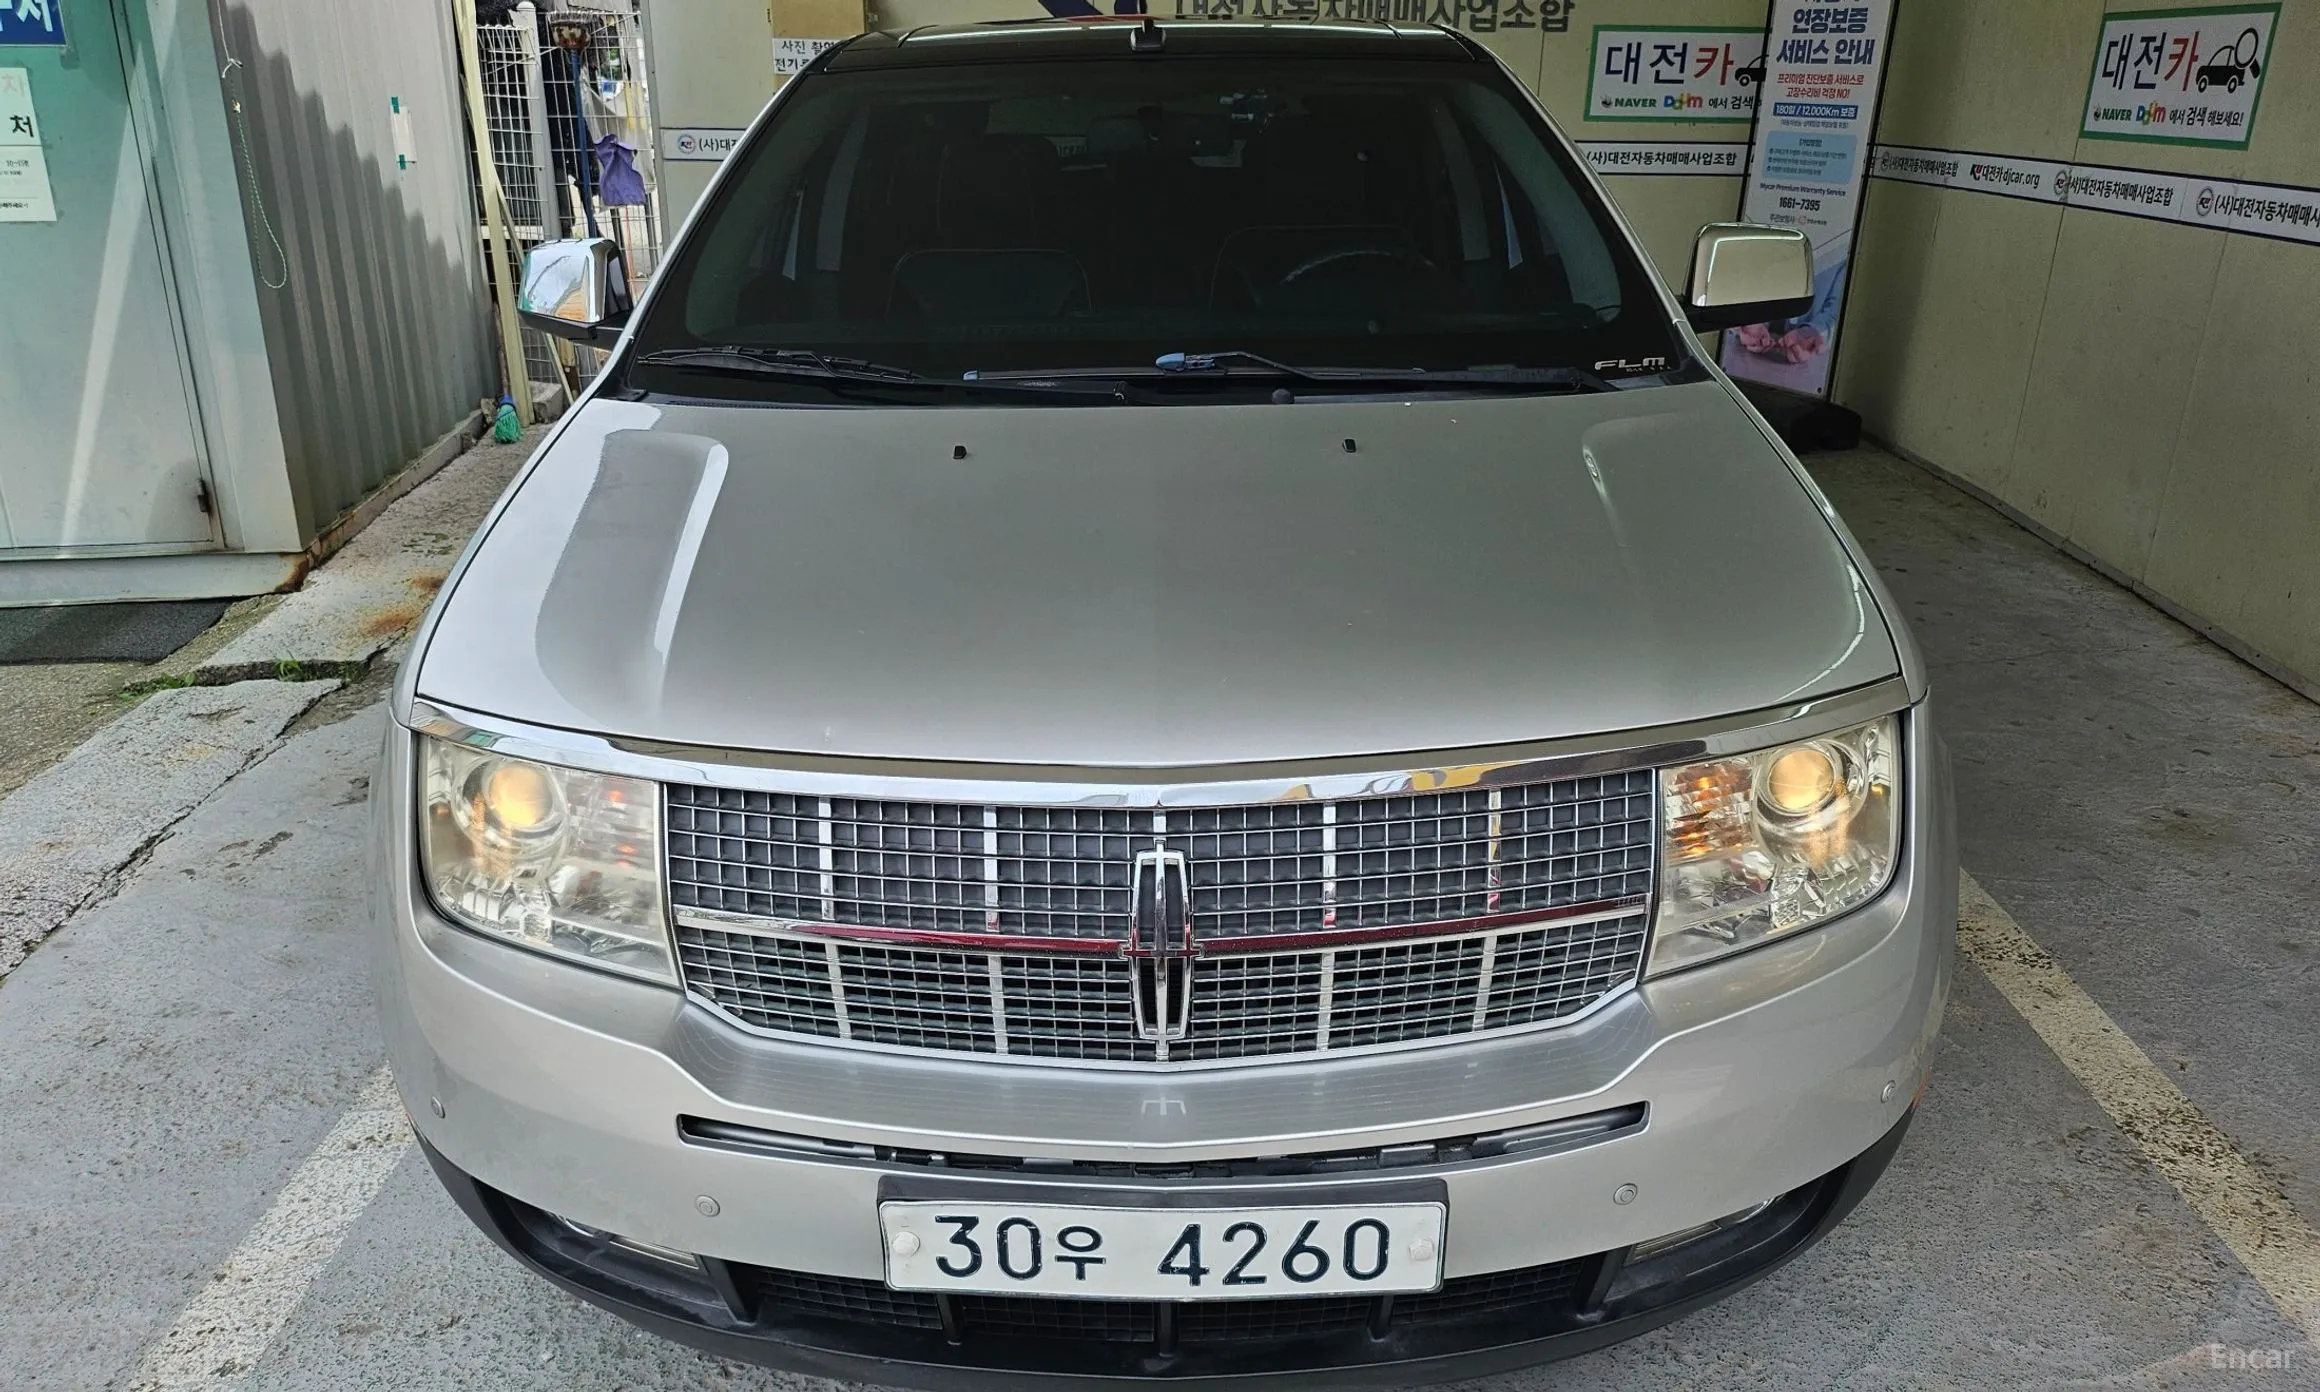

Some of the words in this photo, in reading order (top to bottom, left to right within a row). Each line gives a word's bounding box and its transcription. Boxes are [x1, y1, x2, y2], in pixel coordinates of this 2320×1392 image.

[1792, 8, 1868, 33] 연장보증
[782, 40, 806, 54] 사진
[1776, 40, 1829, 64] 서비스
[1834, 39, 1875, 64] 안내
[1605, 42, 1734, 86] 대전카
[2102, 31, 2200, 92] 대전카
[1777, 73, 1805, 84] 프리미엄
[1806, 74, 1834, 85] 진단보증
[1835, 74, 1865, 85] 서비스로
[1786, 87, 1821, 97] 고장수리비
[1822, 88, 1836, 99] 걱정
[1837, 88, 1851, 99] NO!
[1614, 98, 1657, 108] NAVER
[1708, 97, 1728, 109] 에서
[1776, 105, 1796, 115] 180일
[1840, 107, 1857, 118] 보증
[2102, 107, 2132, 121] NAVER
[2169, 110, 2185, 125] 에서
[2187, 106, 2207, 126] 검색
[2207, 111, 2244, 127] 해보세요!
[1587, 152, 1737, 166] (사)대전자동차매매사업조합
[2003, 168, 2040, 189] djcar.org
[1776, 184, 1799, 192] Premium
[1800, 186, 1825, 196] Warranty
[1826, 188, 1847, 197] Service
[1779, 197, 1821, 211] 1661-7395
[935, 1214, 1106, 1282] 30우
[1157, 1217, 1390, 1287] 4260
